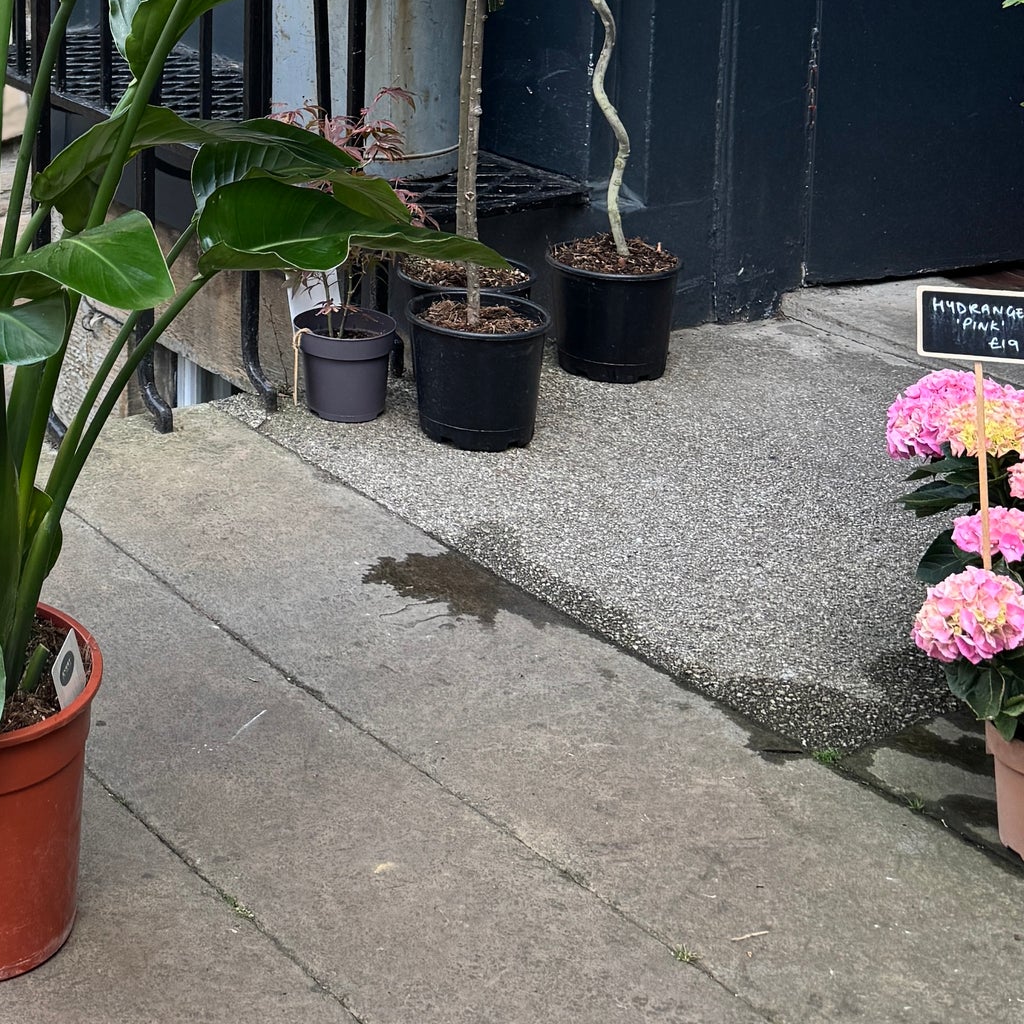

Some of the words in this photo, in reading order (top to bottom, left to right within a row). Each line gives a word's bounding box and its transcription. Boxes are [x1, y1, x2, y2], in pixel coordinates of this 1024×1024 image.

[932, 296, 1024, 319] HYDRANGE
[956, 317, 1005, 331] 'PINK'
[988, 336, 1019, 352] £19
